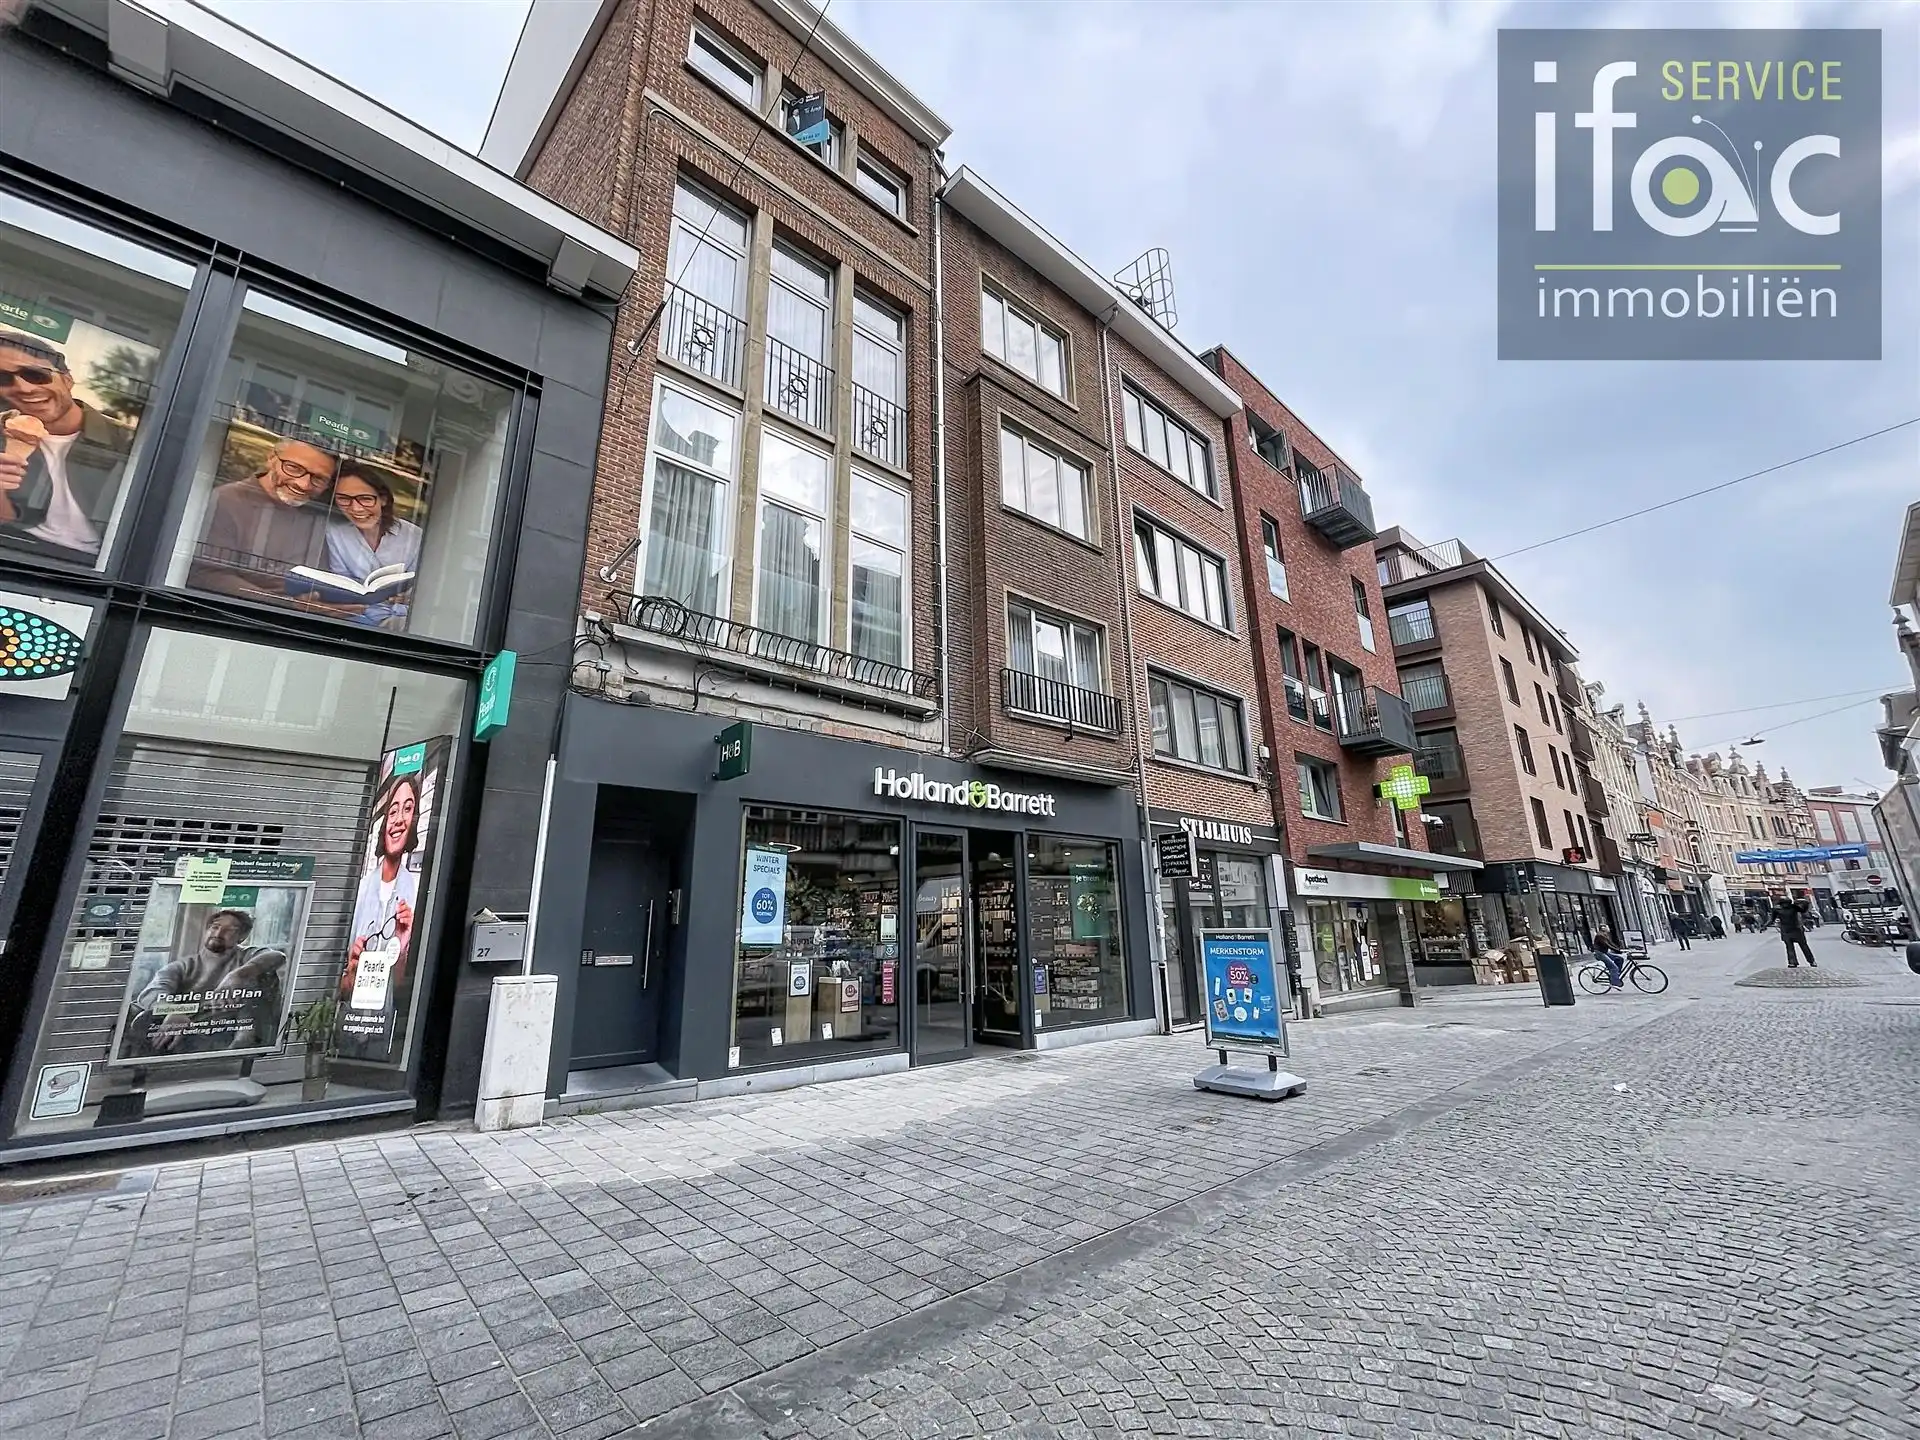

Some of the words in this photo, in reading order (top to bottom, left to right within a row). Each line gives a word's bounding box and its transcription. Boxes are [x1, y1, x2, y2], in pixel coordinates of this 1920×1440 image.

[0, 303, 29, 318] arle
[319, 415, 350, 432] Pearle
[1180, 816, 1253, 845] STIJLHUIS
[756, 854, 780, 865] WINTER
[752, 864, 781, 875] SPECIALS
[756, 899, 774, 911] 60%
[476, 947, 491, 958] 27
[1209, 947, 1265, 956] MERKENSTORM
[363, 960, 385, 973] Pearle
[1230, 970, 1249, 981] 50%
[157, 991, 201, 1003] Pearle
[204, 989, 228, 1001] Bril
[232, 988, 262, 999] Plan
